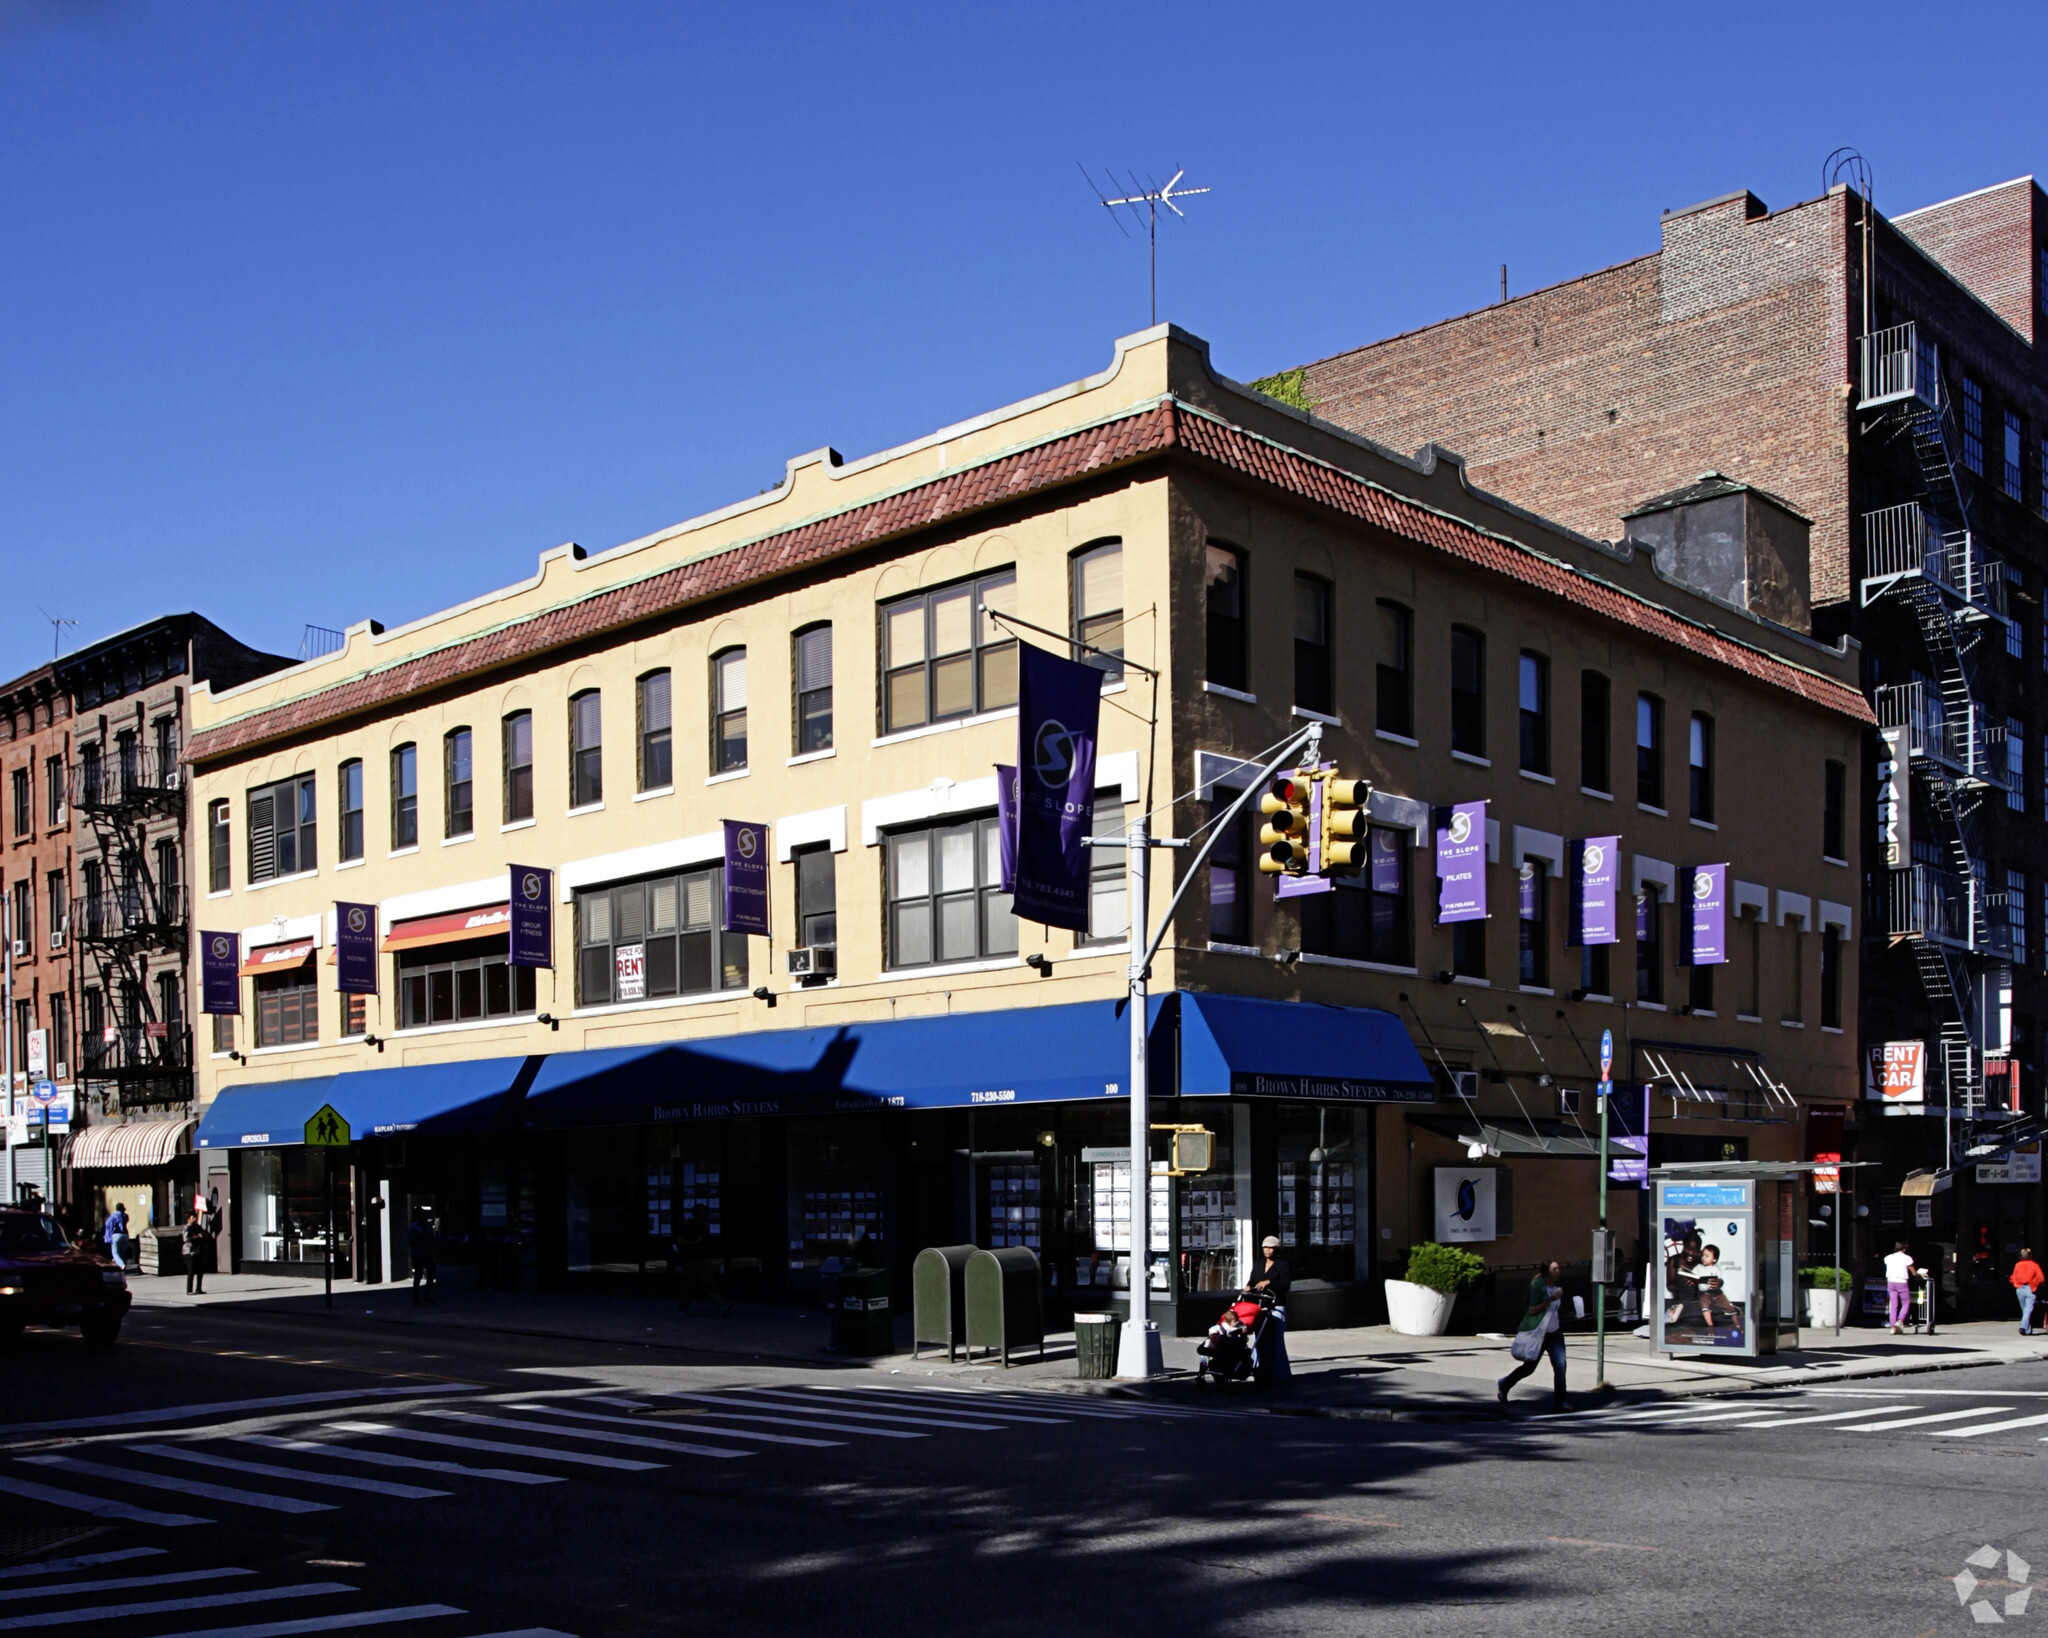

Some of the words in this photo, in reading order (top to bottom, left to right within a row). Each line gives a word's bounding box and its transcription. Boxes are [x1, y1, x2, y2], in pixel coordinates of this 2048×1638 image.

[1045, 797, 1093, 817] SLOPE
[1877, 760, 1900, 843] PARK
[1439, 849, 1453, 857] THE
[1456, 845, 1479, 854] SLOPE
[744, 861, 764, 870] SLOPE
[1446, 872, 1472, 882] PILATES
[521, 921, 542, 929] GROUP
[616, 948, 633, 958] OFFICE
[616, 957, 644, 978] RENT
[1872, 1046, 1916, 1062] RENT
[1877, 1071, 1912, 1087] CAR
[1105, 1083, 1118, 1095] 100
[887, 1096, 905, 1107] 1873
[970, 1090, 1015, 1103] 718-230-5500
[241, 1133, 270, 1144] AEROSOLES
